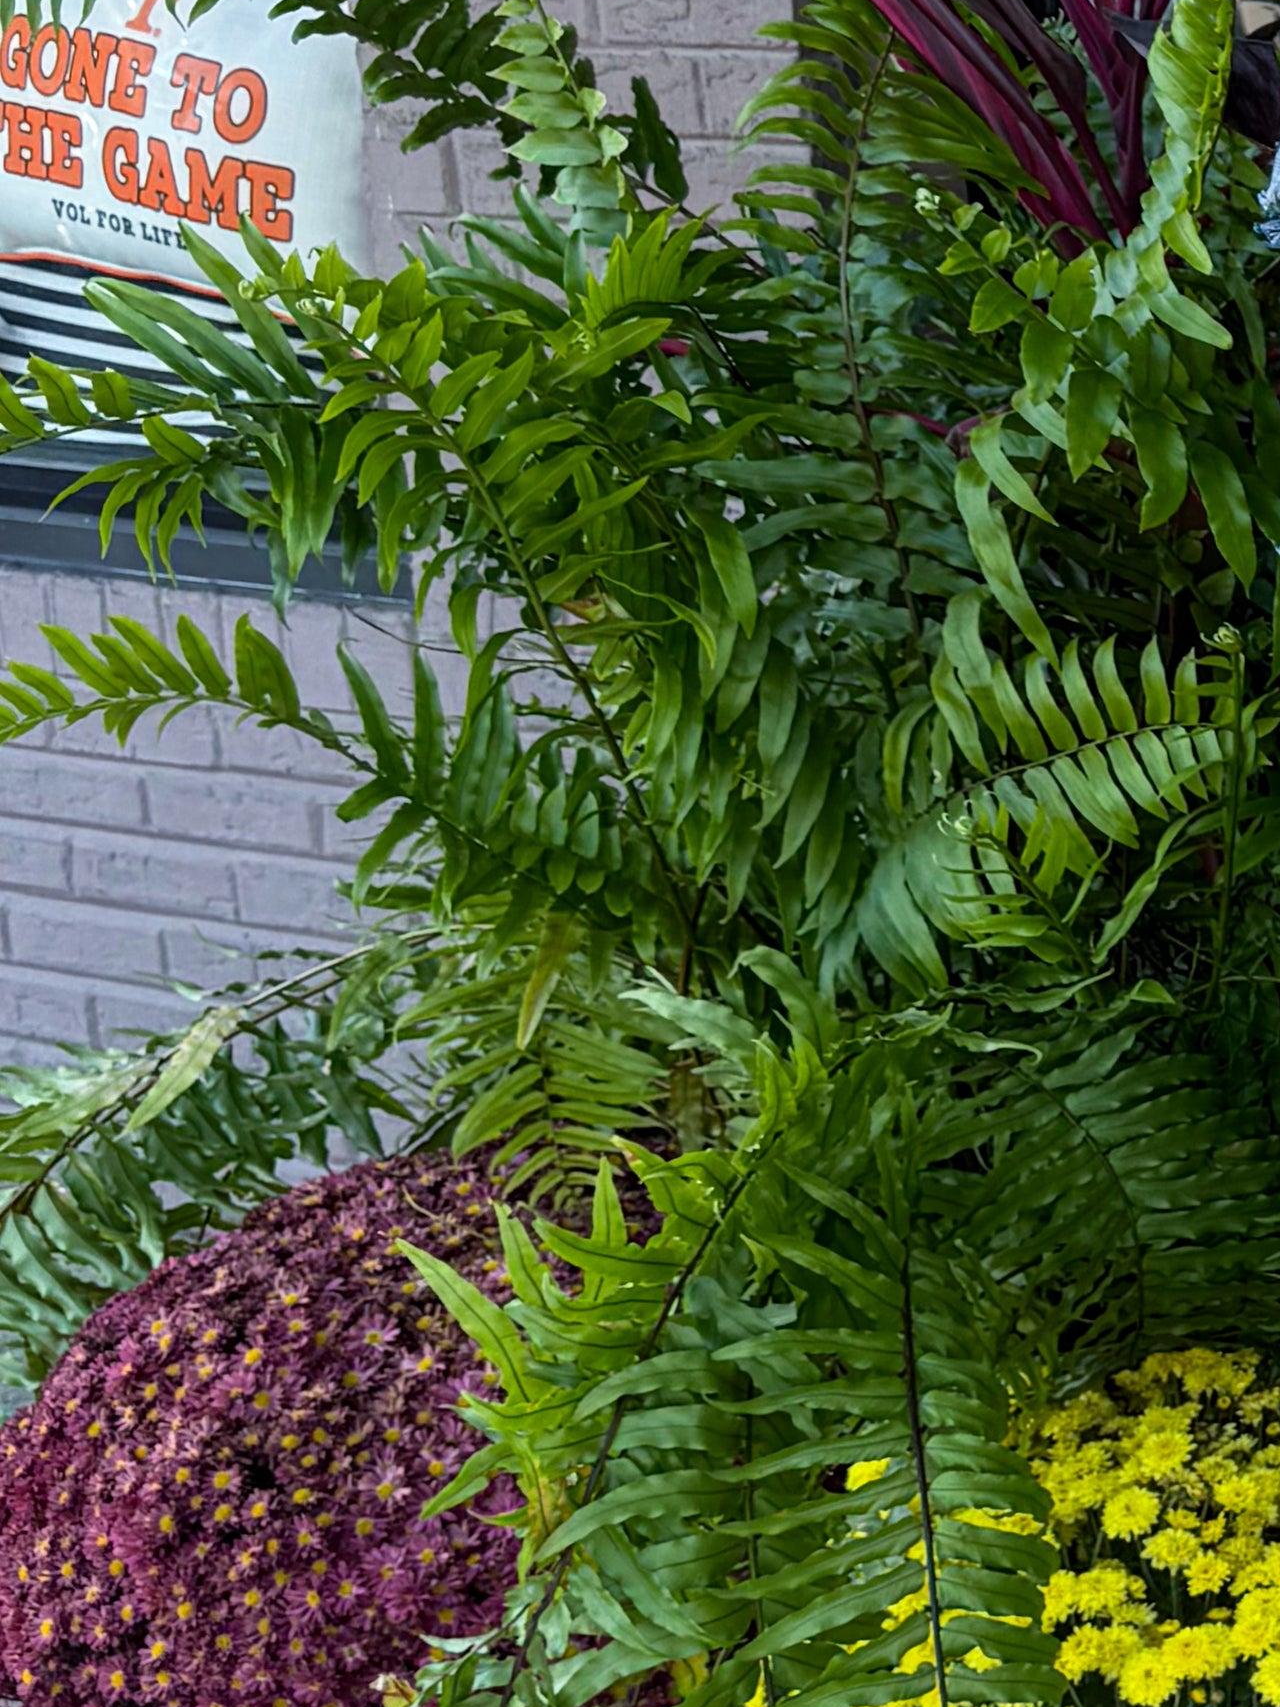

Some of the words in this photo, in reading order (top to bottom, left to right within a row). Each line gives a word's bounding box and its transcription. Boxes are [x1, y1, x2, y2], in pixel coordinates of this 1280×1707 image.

[1, 13, 157, 119] GONE
[170, 52, 268, 144] TO
[51, 198, 91, 226] VOL
[97, 212, 136, 237] FOR
[102, 126, 296, 243] GAME
